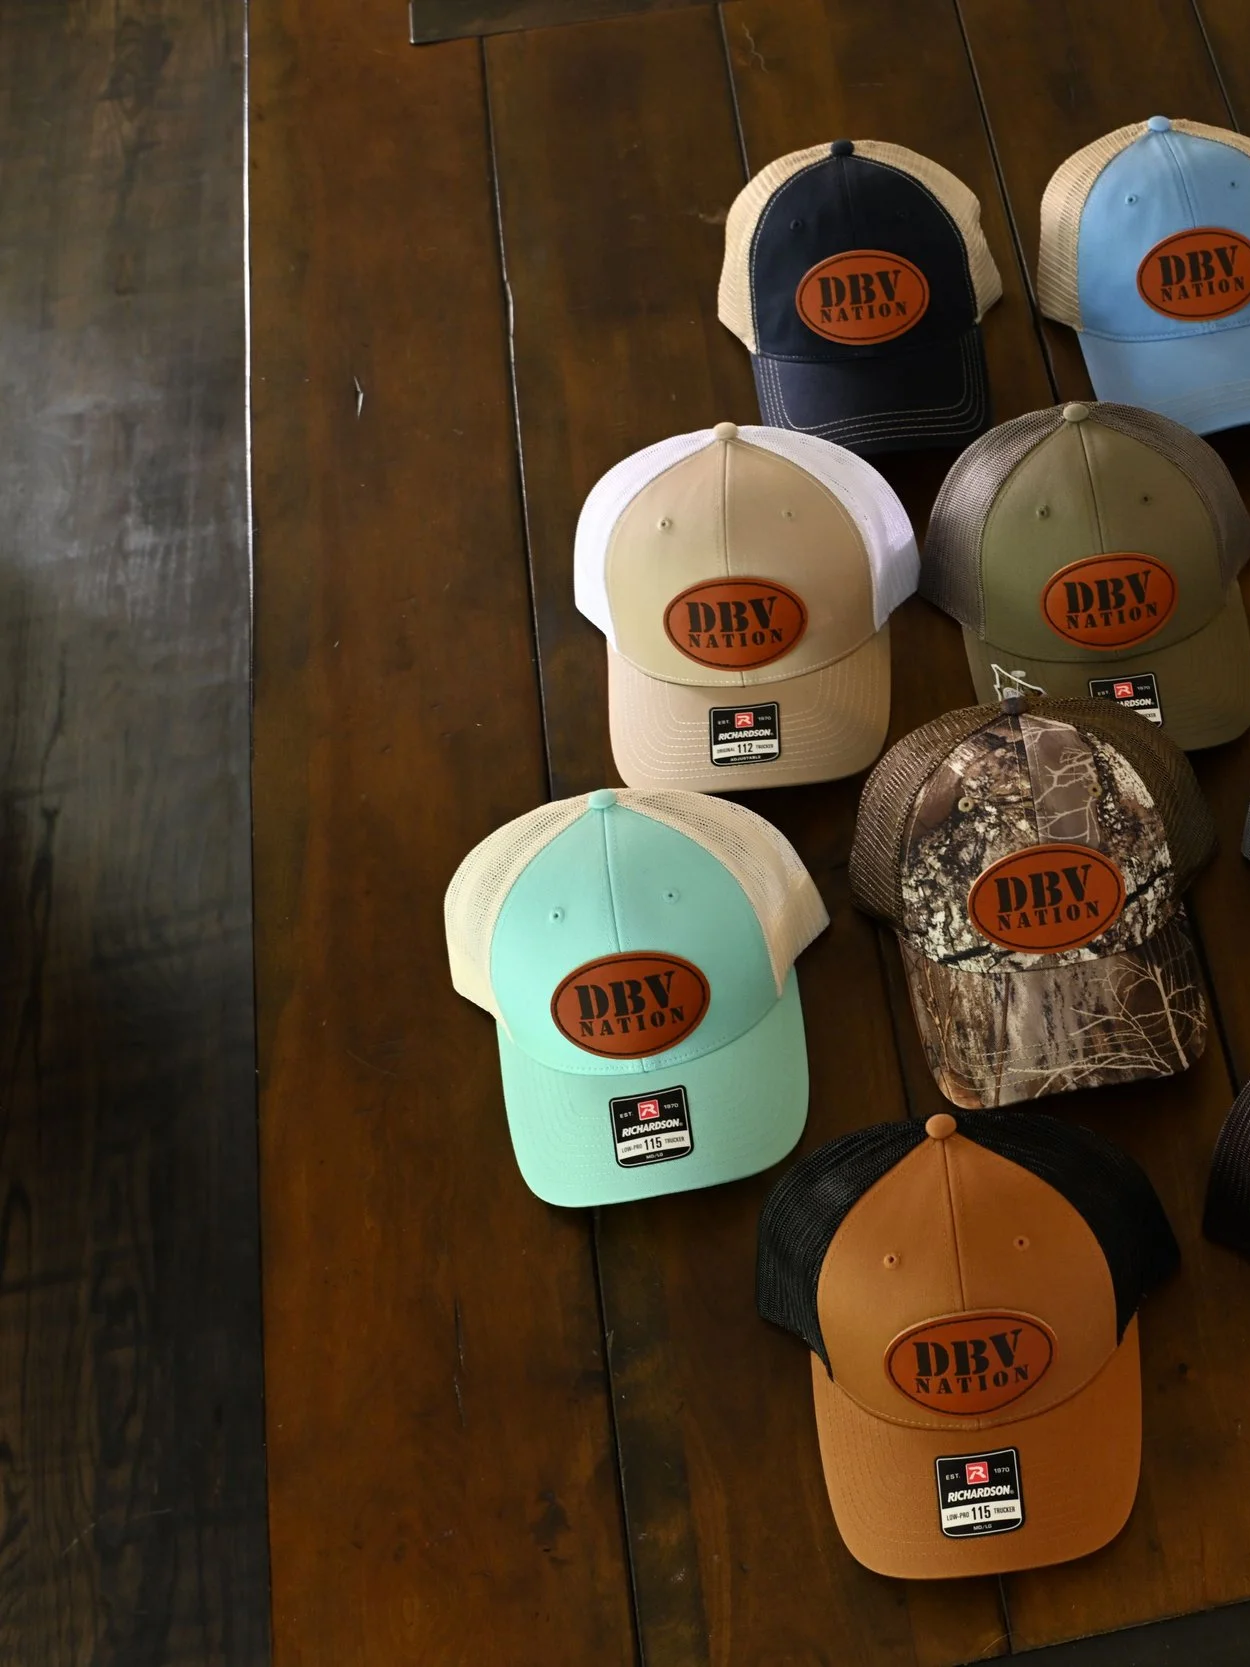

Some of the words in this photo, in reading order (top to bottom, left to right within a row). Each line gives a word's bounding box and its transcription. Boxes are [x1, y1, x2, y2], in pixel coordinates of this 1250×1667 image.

[1157, 245, 1239, 287] DBV
[817, 269, 902, 308] DBV
[1160, 276, 1245, 302] NATION
[820, 301, 908, 324] NATION
[1063, 569, 1152, 614] DBV
[685, 595, 778, 633] DBV
[1065, 601, 1158, 630] NATION
[688, 627, 784, 649] NATION
[718, 728, 772, 741] RICHARDSON
[737, 743, 753, 754] 112
[994, 863, 1093, 914] DBV
[997, 900, 1100, 932] NATION
[573, 969, 675, 1021] DBV
[579, 1005, 685, 1037] NATION
[621, 1118, 680, 1138] RICHARDSON
[644, 1136, 662, 1150] 115
[912, 1328, 1023, 1377] DBV
[914, 1363, 1030, 1395] NATION
[993, 1466, 1010, 1474] 1970
[947, 1485, 1011, 1503] RICHARDSON
[971, 1504, 991, 1520] 115
[993, 1506, 1016, 1514] TRUCKER
